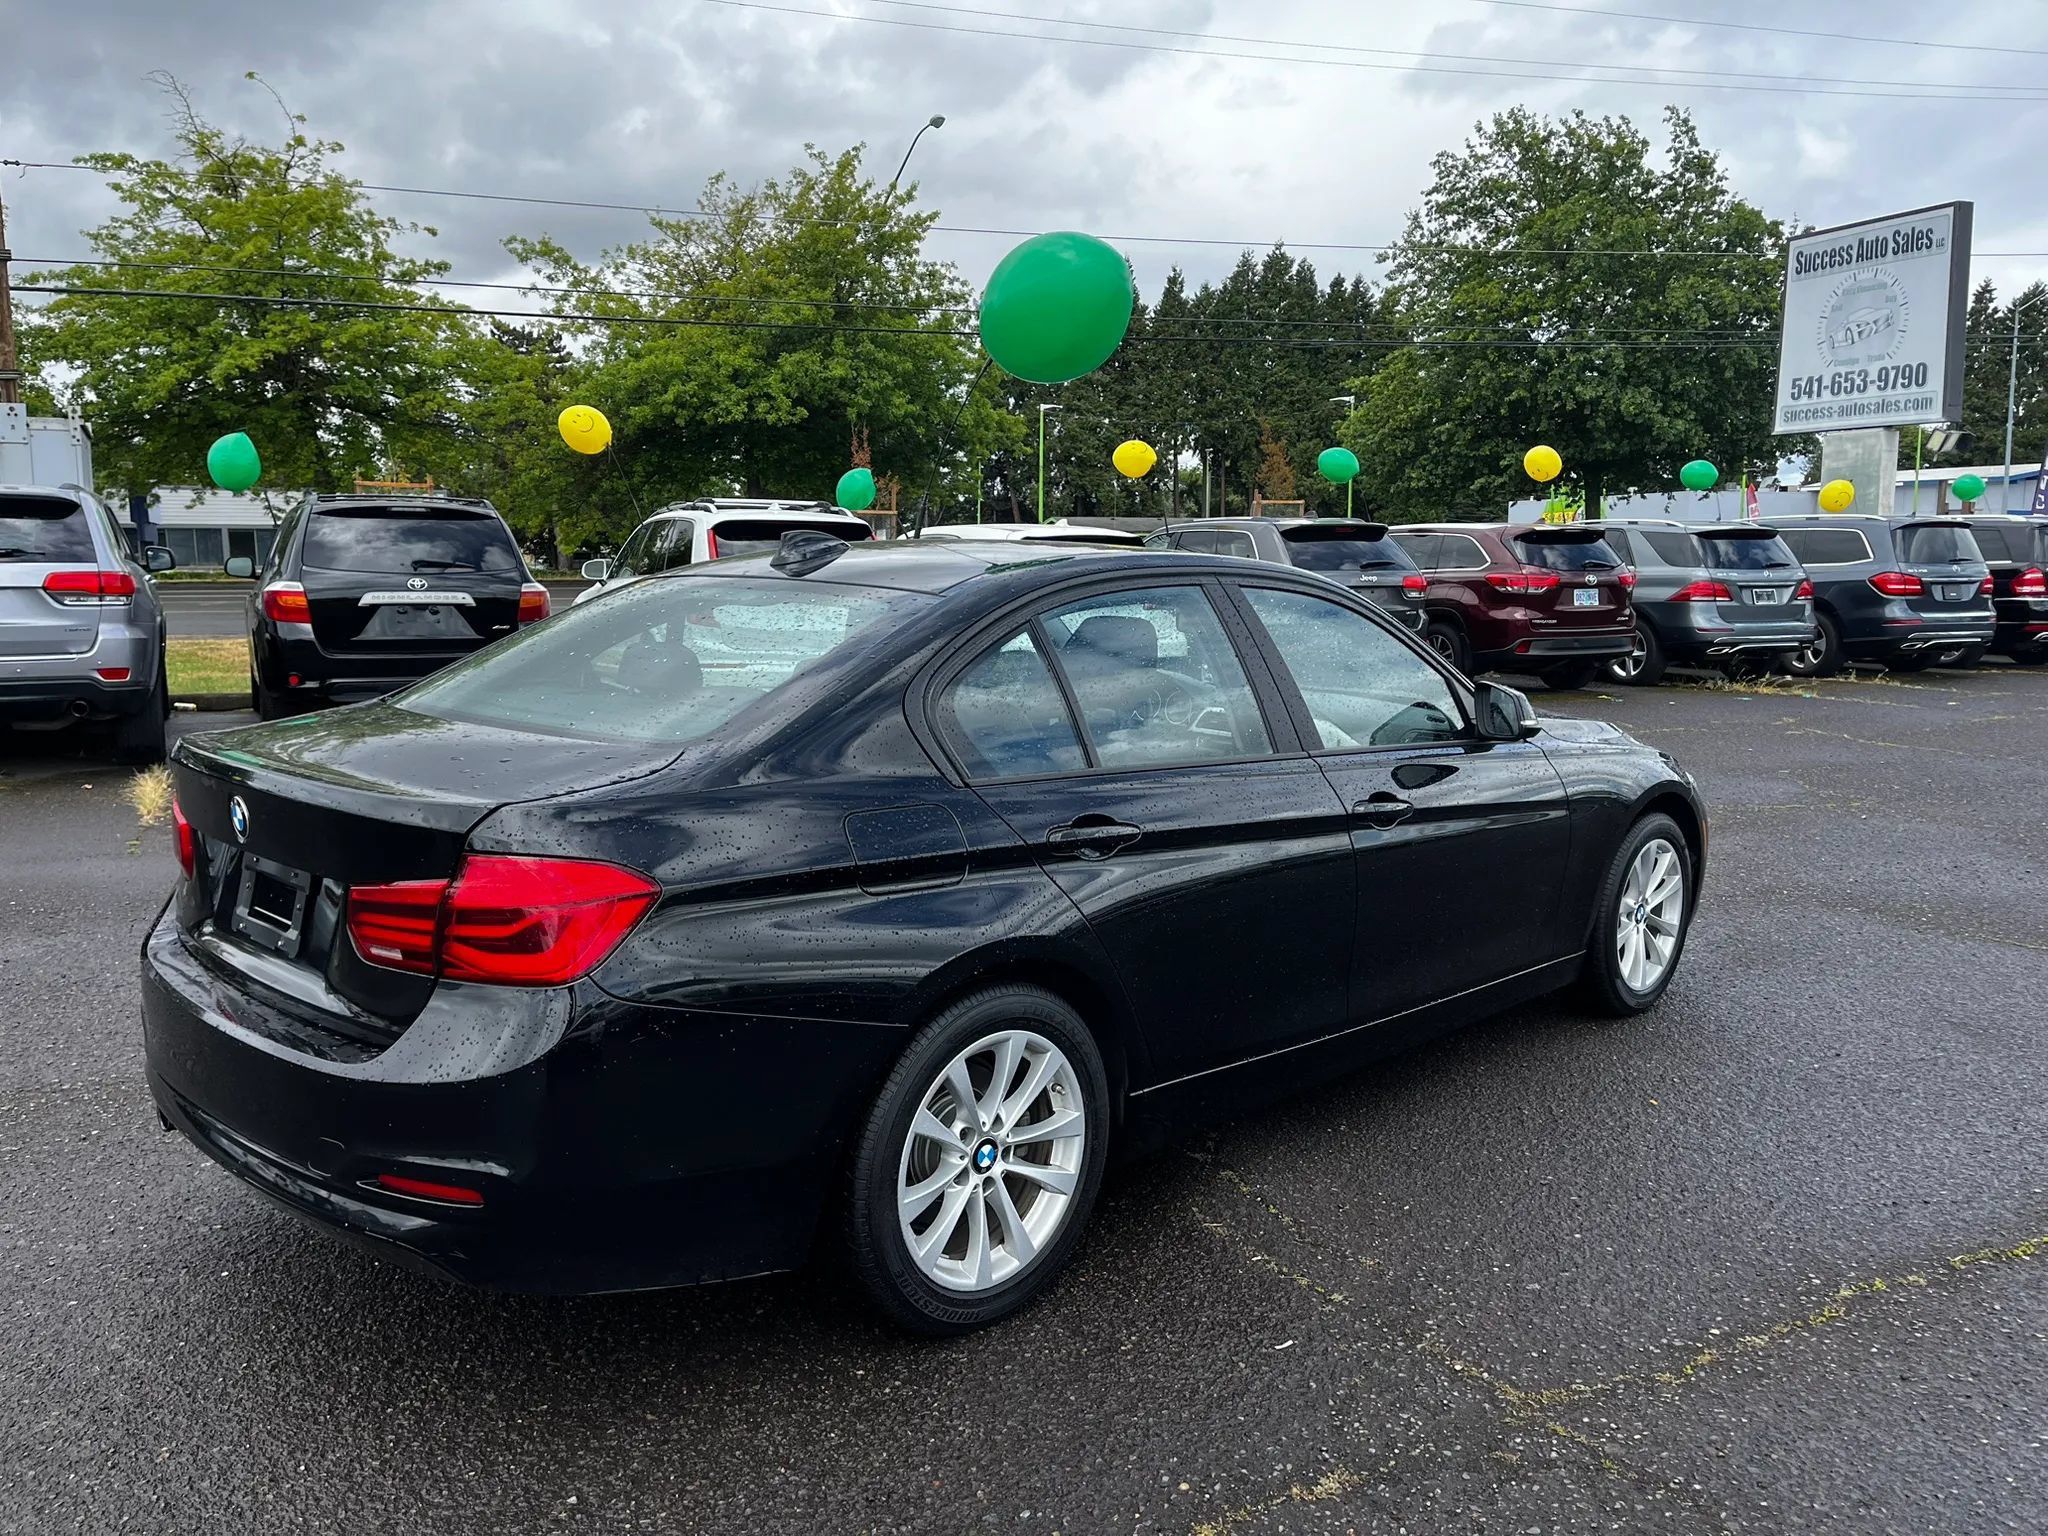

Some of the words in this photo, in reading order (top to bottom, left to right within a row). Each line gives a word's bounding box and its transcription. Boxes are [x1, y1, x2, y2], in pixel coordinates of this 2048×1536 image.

[1795, 244, 1853, 275] Success
[1855, 236, 1888, 263] Auto
[1892, 226, 1934, 256] Sales
[1936, 237, 1945, 248] LLC
[1790, 362, 1928, 400] 541-653-9790
[1783, 396, 1933, 423] success-autosales.com
[1359, 574, 1378, 583] Jeep
